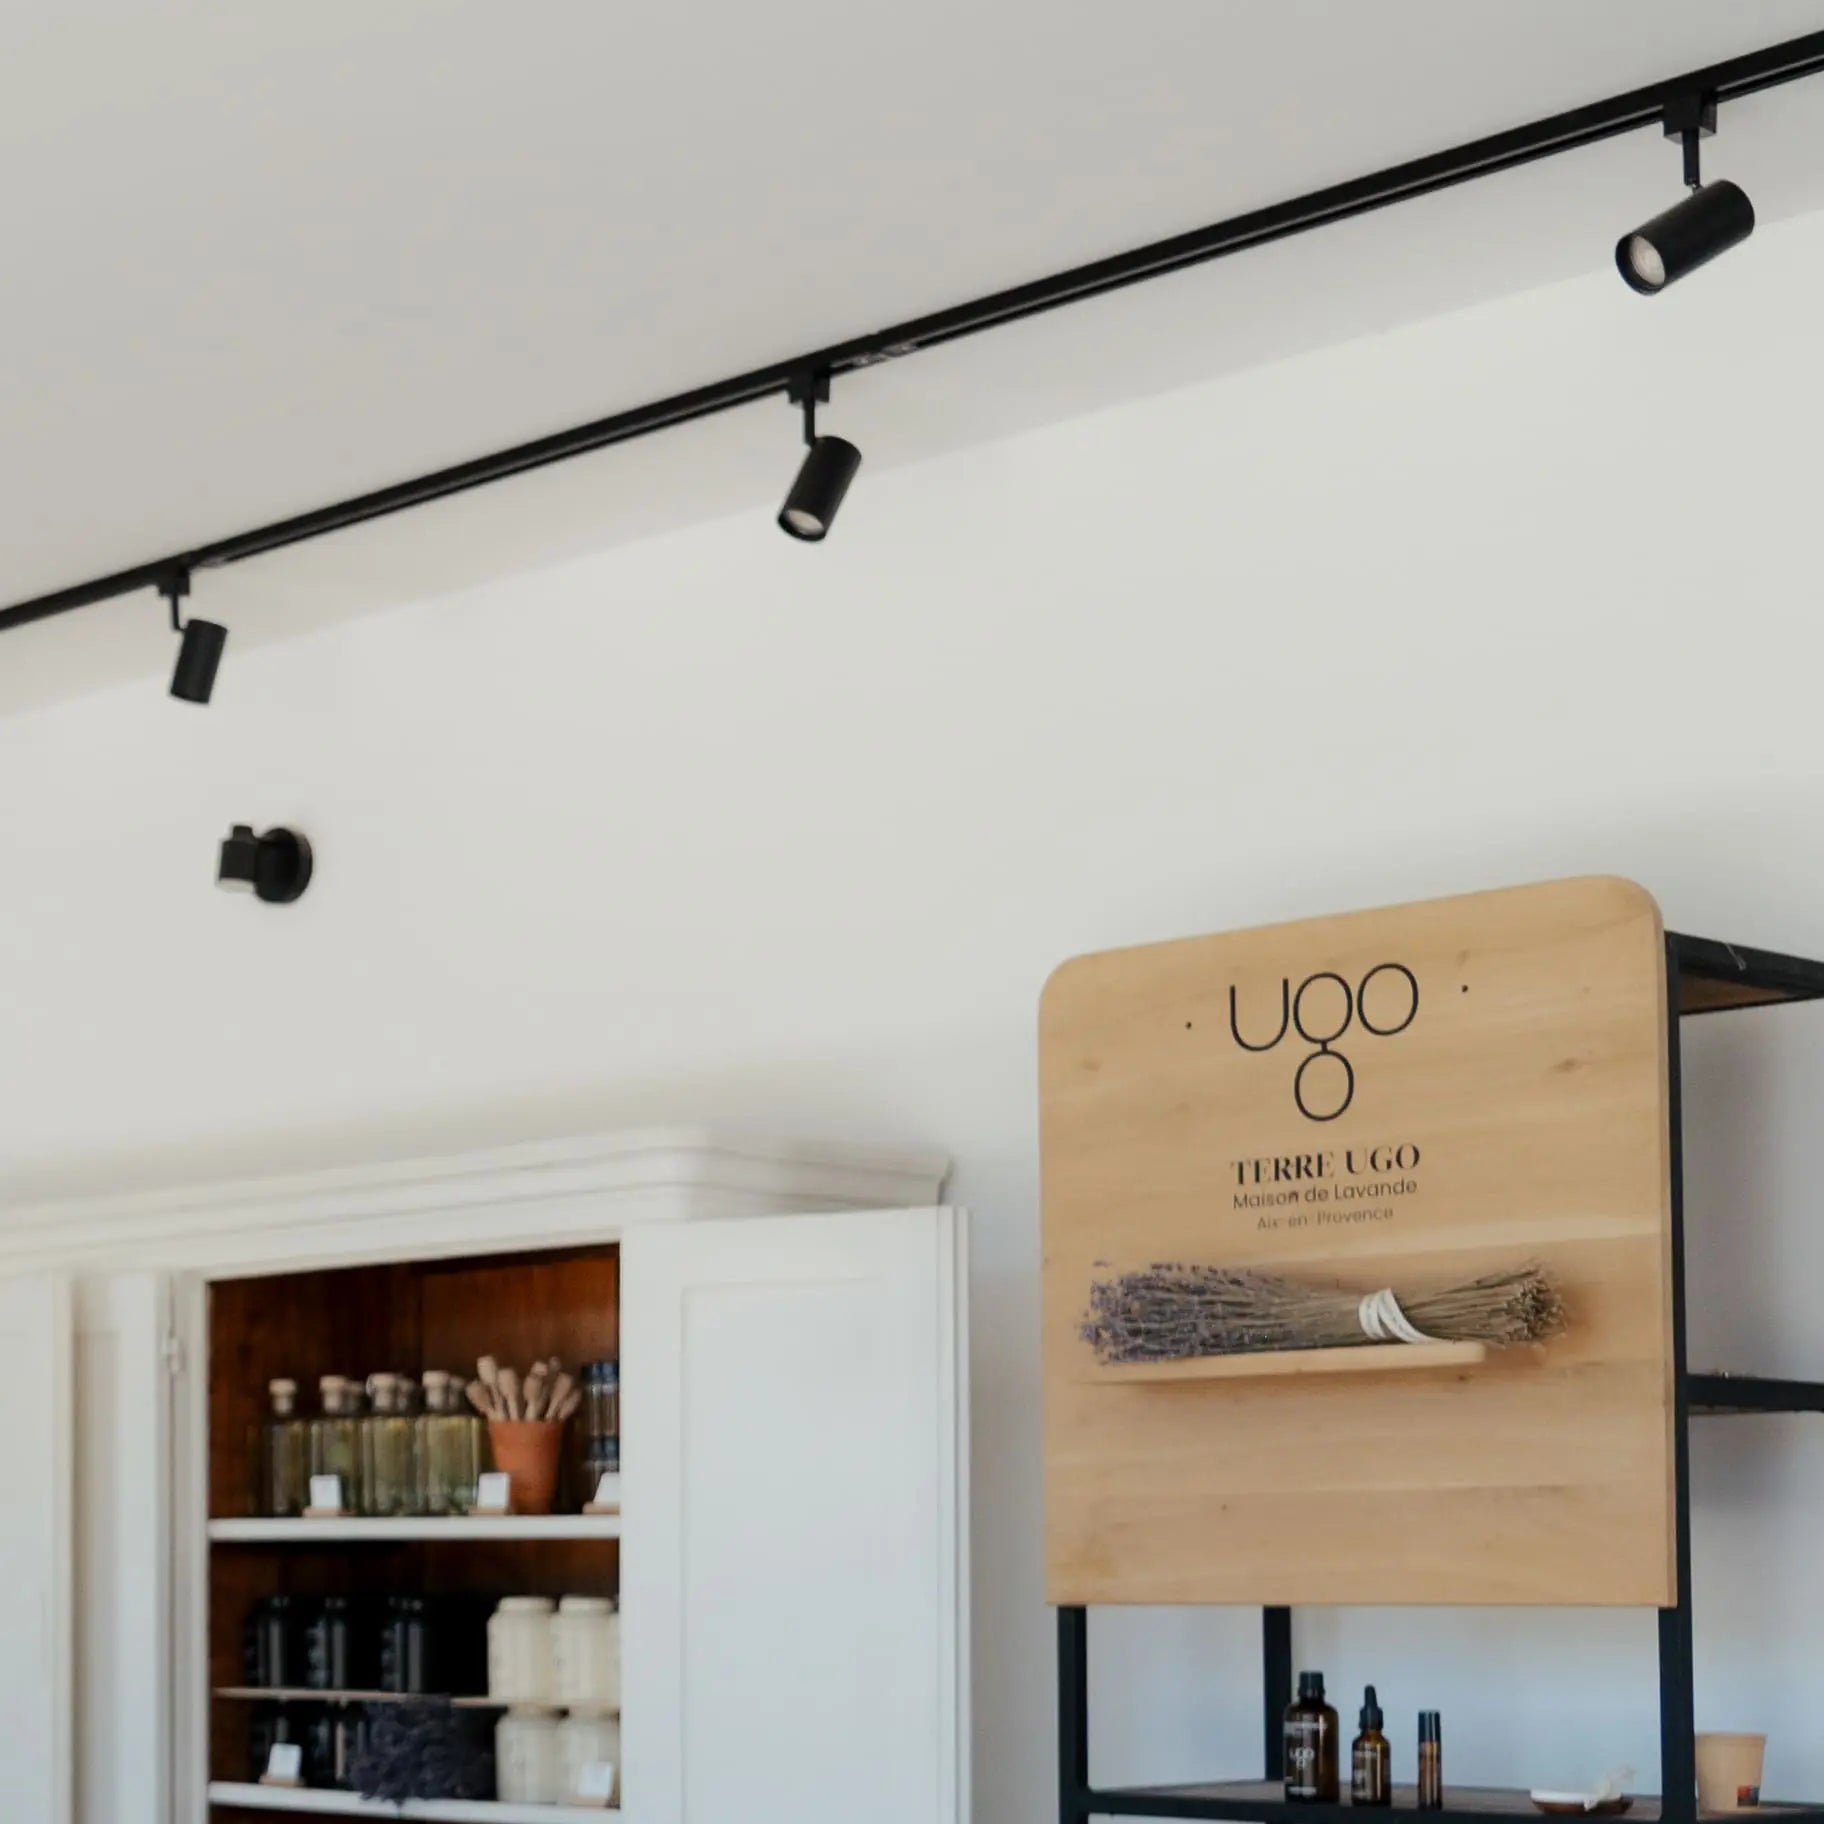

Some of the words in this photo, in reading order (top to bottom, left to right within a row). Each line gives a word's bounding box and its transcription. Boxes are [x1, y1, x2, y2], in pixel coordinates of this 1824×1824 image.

[1230, 1150, 1336, 1186] TERRE
[1345, 1142, 1420, 1175] UGO
[1233, 1189, 1299, 1209] Maison
[1304, 1187, 1328, 1203] de
[1334, 1177, 1417, 1200] Lavande
